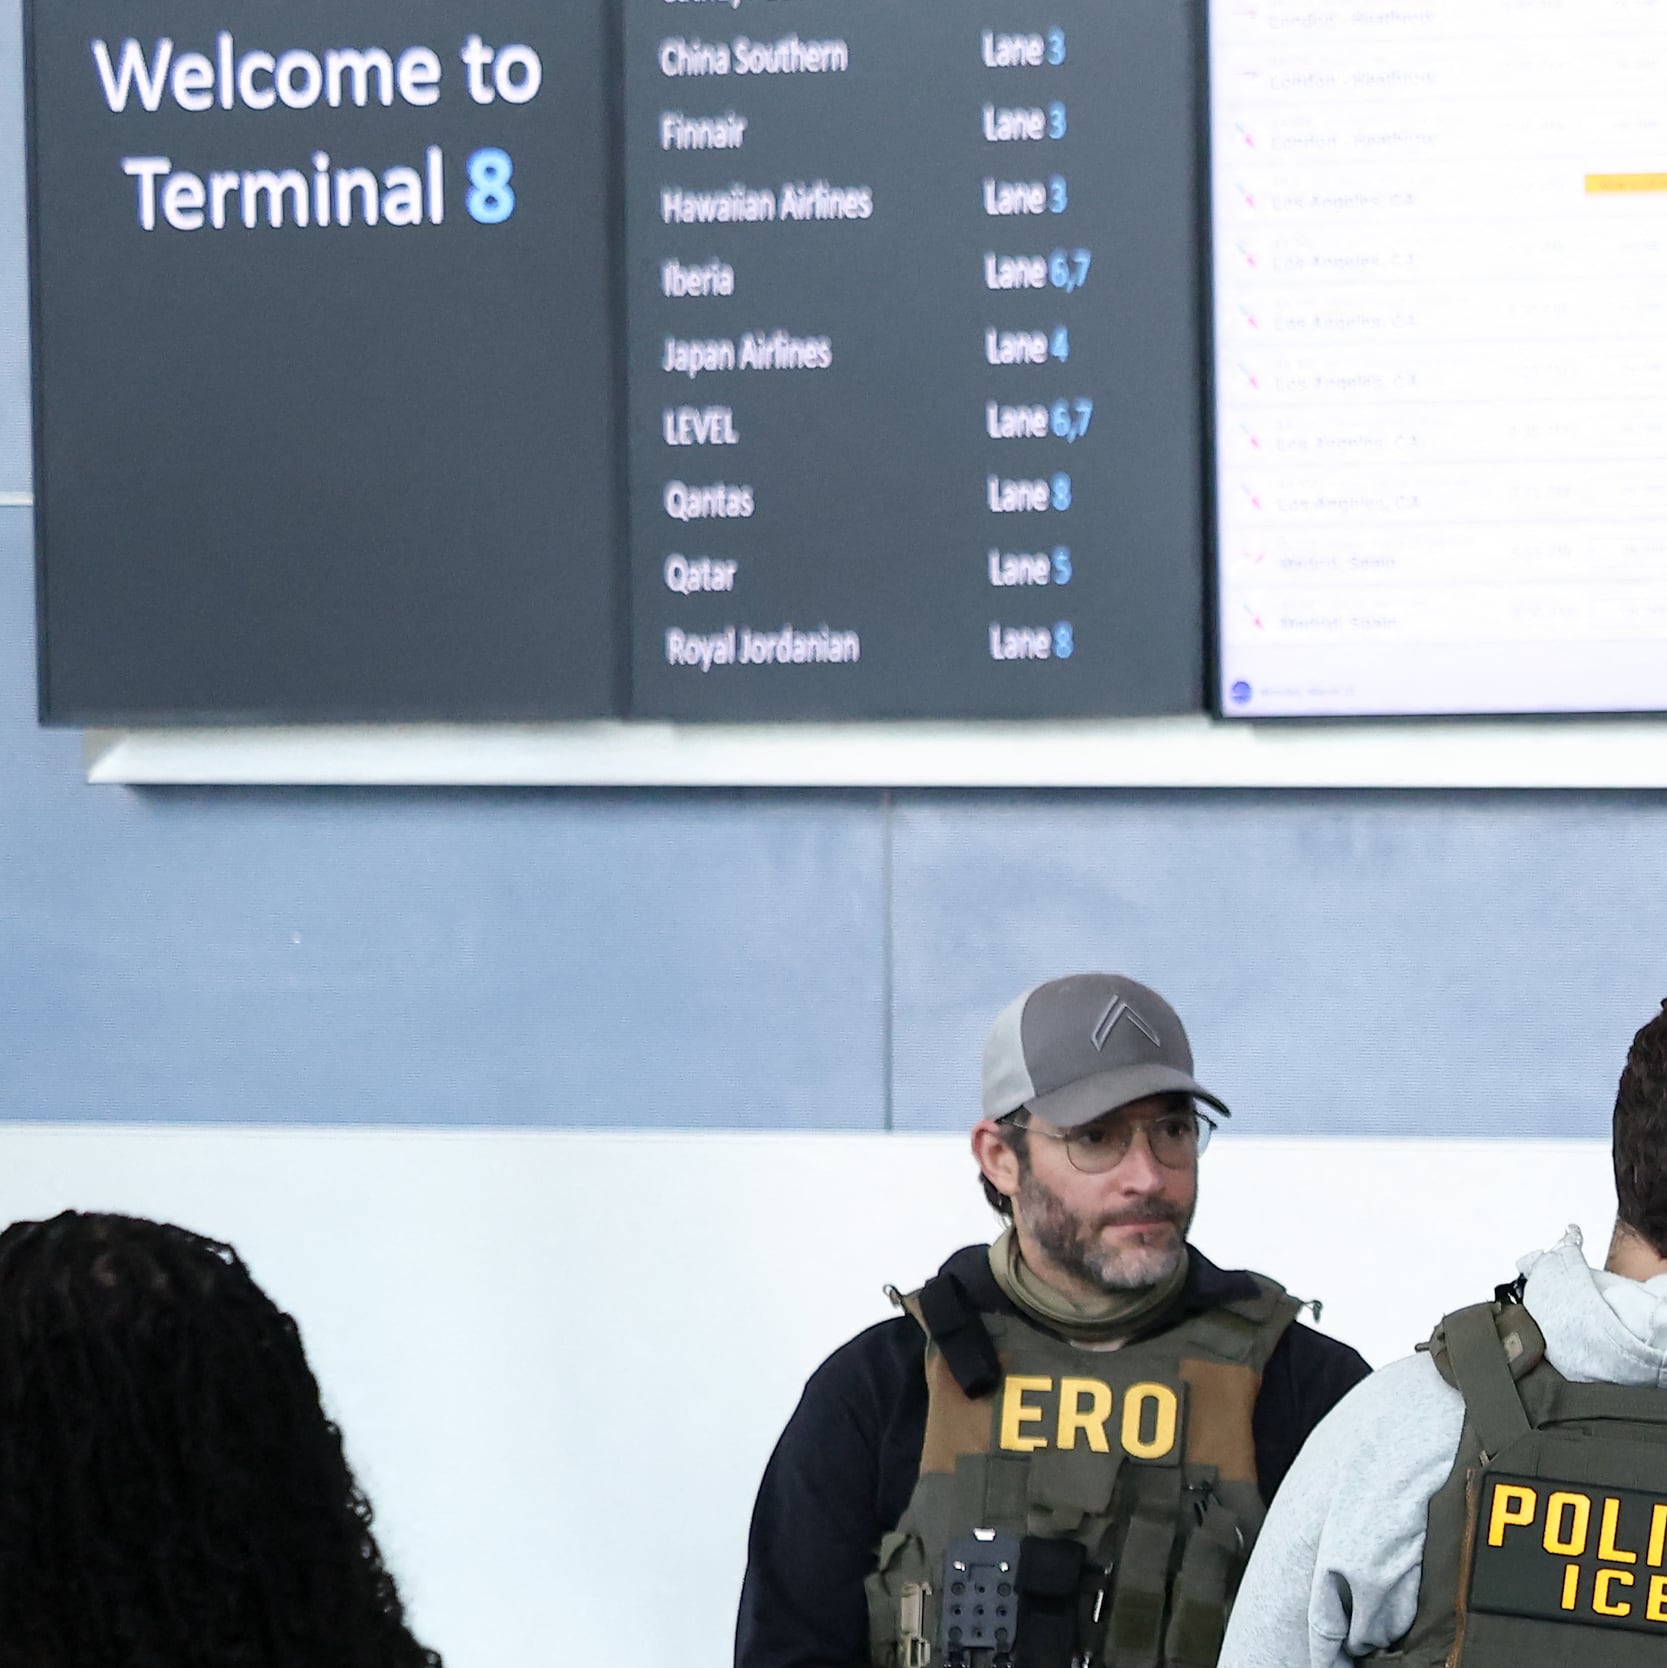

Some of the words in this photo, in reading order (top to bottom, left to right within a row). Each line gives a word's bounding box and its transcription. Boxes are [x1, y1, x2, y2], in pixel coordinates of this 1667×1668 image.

[659, 39, 732, 77] China
[734, 35, 849, 75] Southern
[983, 33, 1045, 68] Lane
[1048, 27, 1067, 66] 3
[92, 33, 442, 113] Welcome
[460, 35, 542, 106] to
[661, 113, 748, 151] Finnair
[984, 107, 1046, 142] Lane
[1050, 102, 1068, 140] 3
[122, 146, 444, 231] Terminal
[466, 148, 516, 224] 8
[662, 184, 777, 224] Hawaiian
[779, 181, 874, 221] Airlines
[984, 179, 1046, 216] Lane
[1050, 176, 1069, 214] 3
[663, 261, 735, 297] Iberia
[985, 254, 1046, 290] Lane
[1049, 249, 1092, 294] 6,7
[663, 339, 736, 379] Japan
[738, 331, 833, 370] Airlines
[986, 329, 1046, 365] Lane
[1049, 327, 1070, 363] 4
[664, 407, 739, 446] LEVEL
[987, 403, 1048, 439] Lane
[1050, 399, 1094, 444] 6,7
[665, 482, 755, 522] Qantas
[988, 477, 1049, 513] Lane
[1051, 473, 1073, 512] 8
[665, 555, 738, 596] Qatar
[989, 551, 1050, 586] Lane
[1052, 547, 1073, 586] 5
[666, 628, 737, 672] Royal
[739, 627, 861, 665] Jordanian
[990, 625, 1050, 660] Lane
[1053, 622, 1074, 659] 8
[1000, 1375, 1177, 1460] ERO
